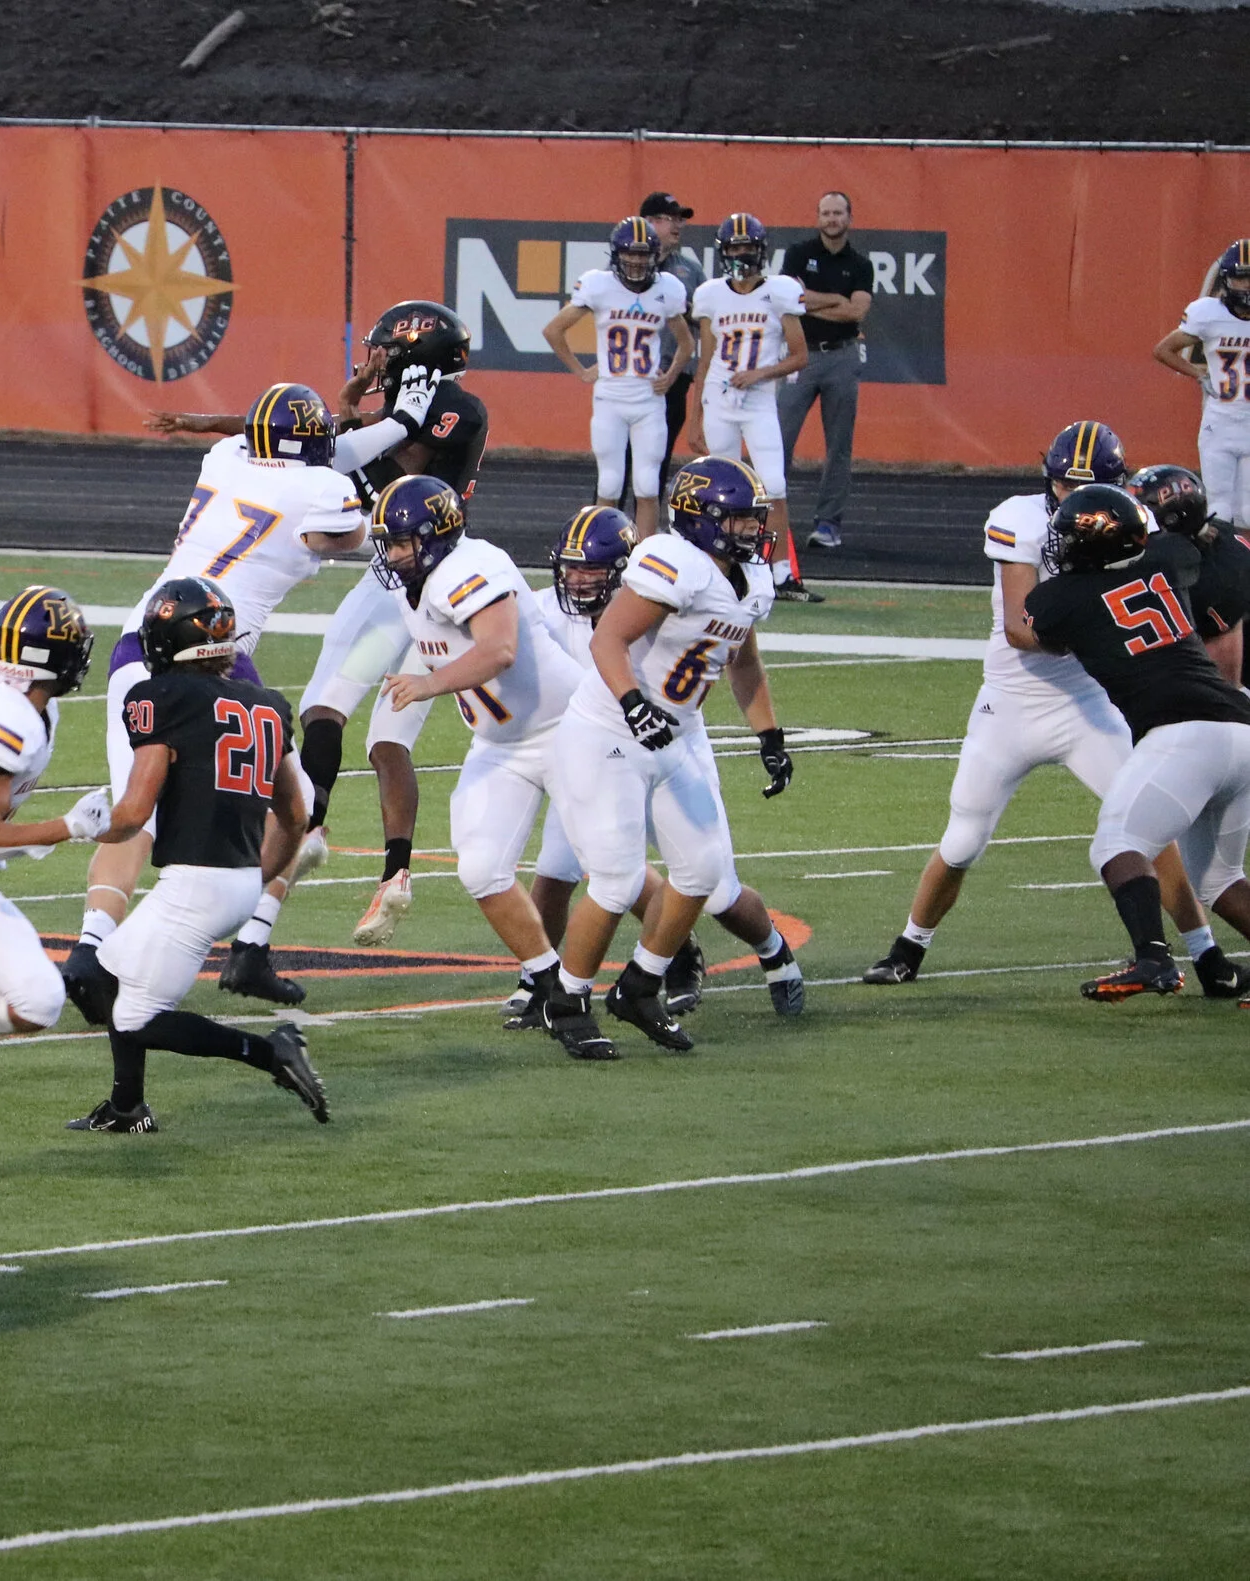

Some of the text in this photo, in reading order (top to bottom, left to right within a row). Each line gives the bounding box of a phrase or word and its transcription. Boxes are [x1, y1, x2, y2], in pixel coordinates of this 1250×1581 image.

[607, 324, 656, 377] 85
[720, 327, 765, 373] 41
[670, 471, 711, 515] K
[175, 484, 284, 580] 77
[1101, 572, 1195, 656] 51
[127, 699, 155, 734] 20
[213, 696, 284, 800] 20
